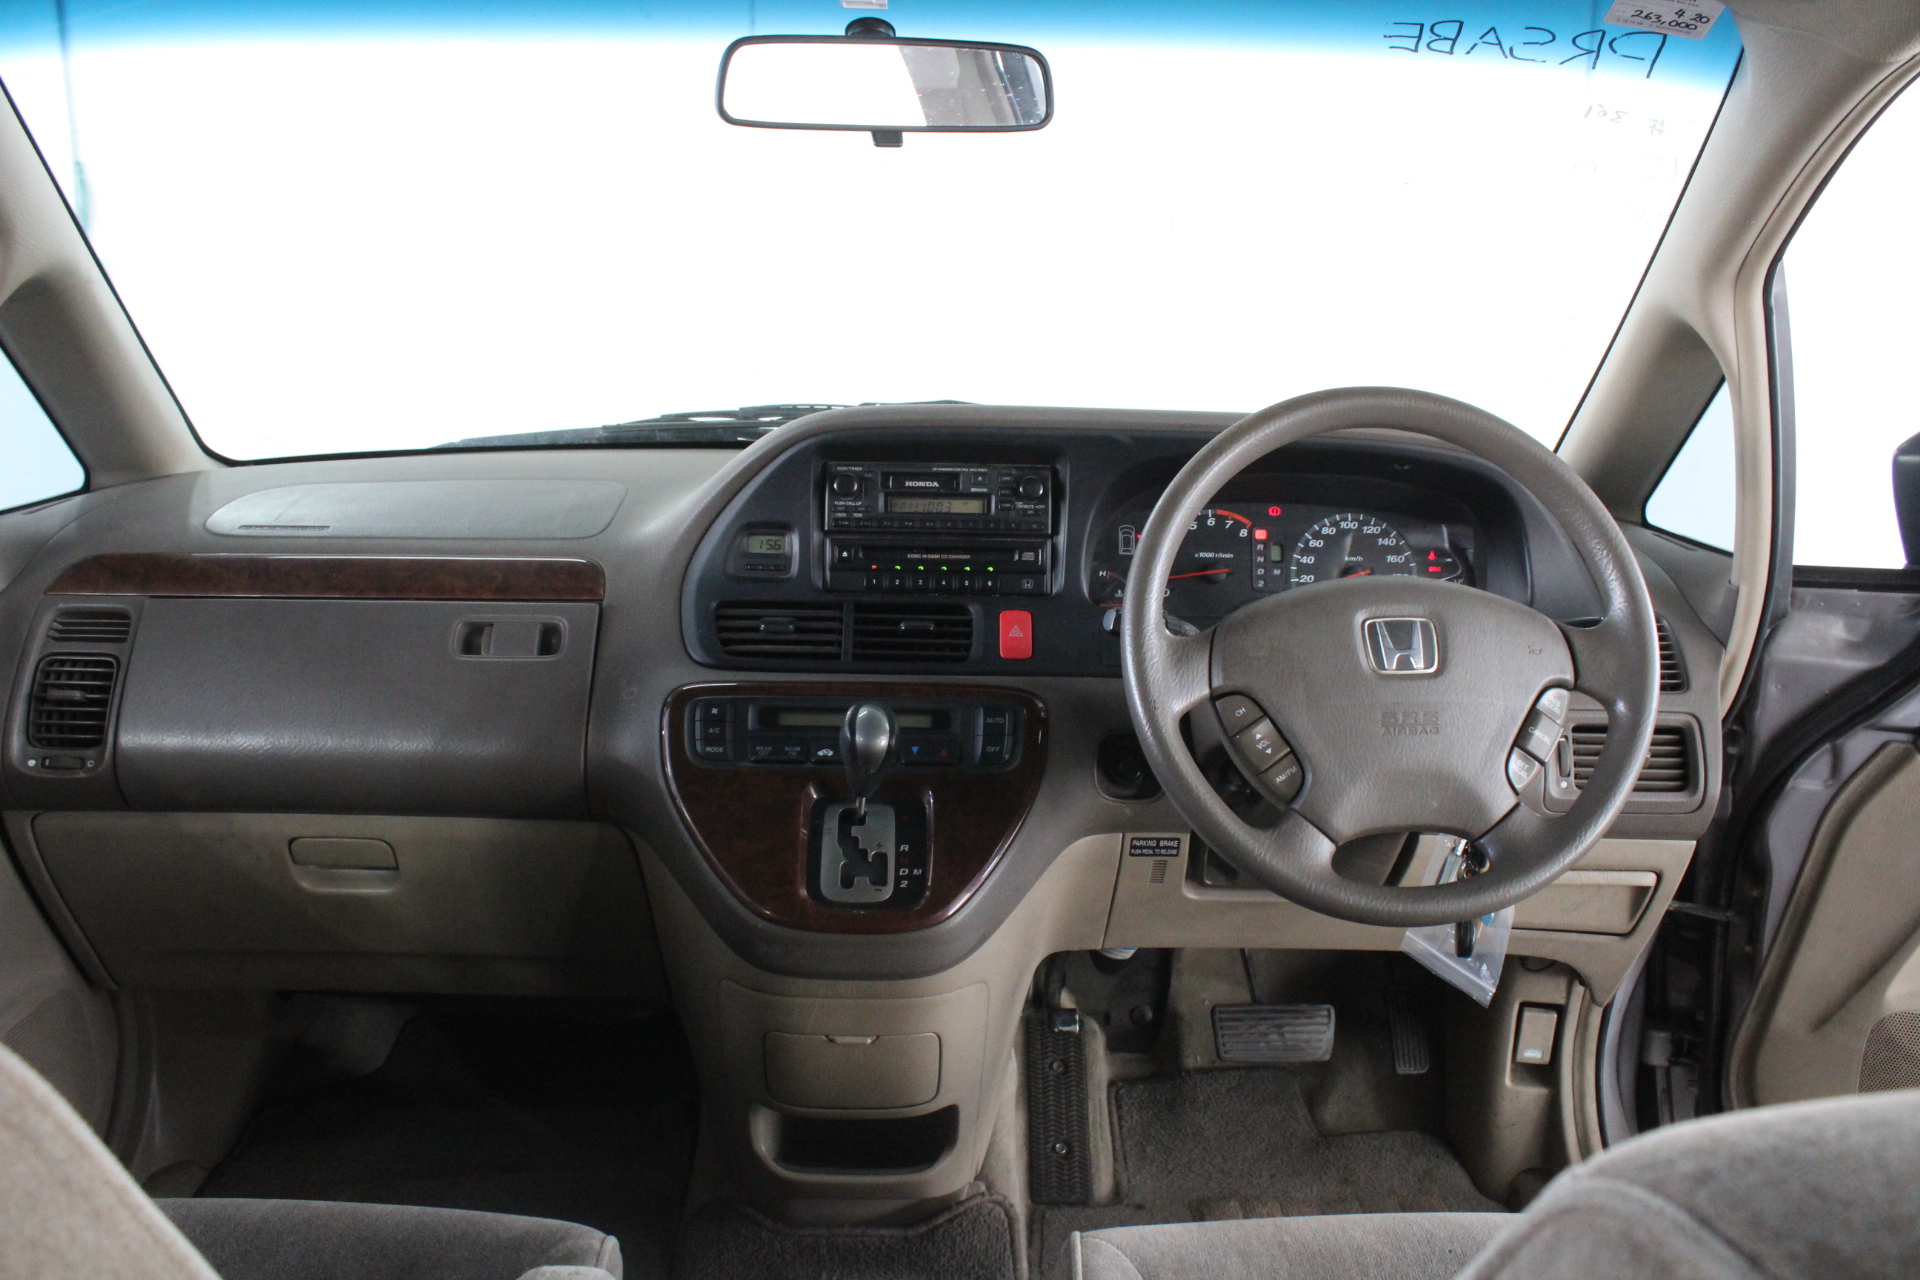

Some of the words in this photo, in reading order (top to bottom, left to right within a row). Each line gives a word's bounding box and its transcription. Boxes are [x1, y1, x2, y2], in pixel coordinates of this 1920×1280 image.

[1207, 518, 1216, 526] 6
[1225, 520, 1233, 529] 7
[1339, 521, 1358, 530] 100
[1239, 528, 1248, 537] 8
[1321, 526, 1336, 535] 80
[1362, 526, 1381, 534] 120
[1309, 539, 1324, 548] 60
[1377, 538, 1396, 546] 140
[1300, 556, 1315, 564] 40
[1386, 555, 1405, 563] 160
[1300, 575, 1315, 583] 20
[1235, 707, 1246, 717] CH
[1528, 726, 1551, 745] CANCEL
[1255, 739, 1271, 750] VOL
[1275, 765, 1298, 784] AM/FM
[899, 844, 909, 852] R
[1159, 840, 1179, 848] BRAKE
[899, 868, 909, 876] D
[899, 880, 909, 888] 2
